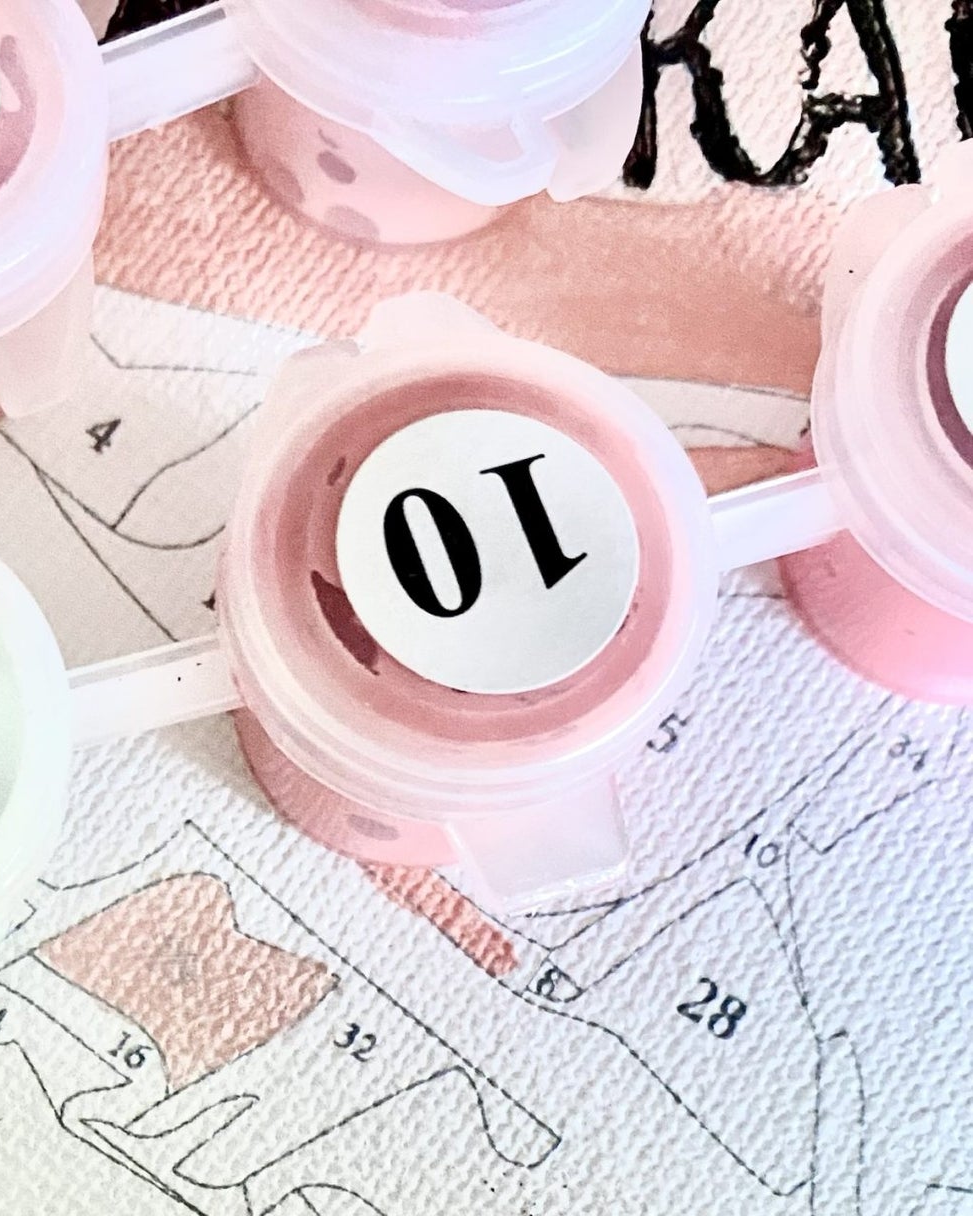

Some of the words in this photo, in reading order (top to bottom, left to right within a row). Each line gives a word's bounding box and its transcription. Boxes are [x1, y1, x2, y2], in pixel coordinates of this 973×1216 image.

[86, 419, 121, 453] 4
[384, 454, 587, 617] 10
[646, 713, 690, 753] 5
[744, 834, 780, 867] 10
[536, 967, 560, 997] 8
[677, 977, 747, 1039] 28
[107, 1028, 153, 1070] 16
[334, 1023, 376, 1062] 32
